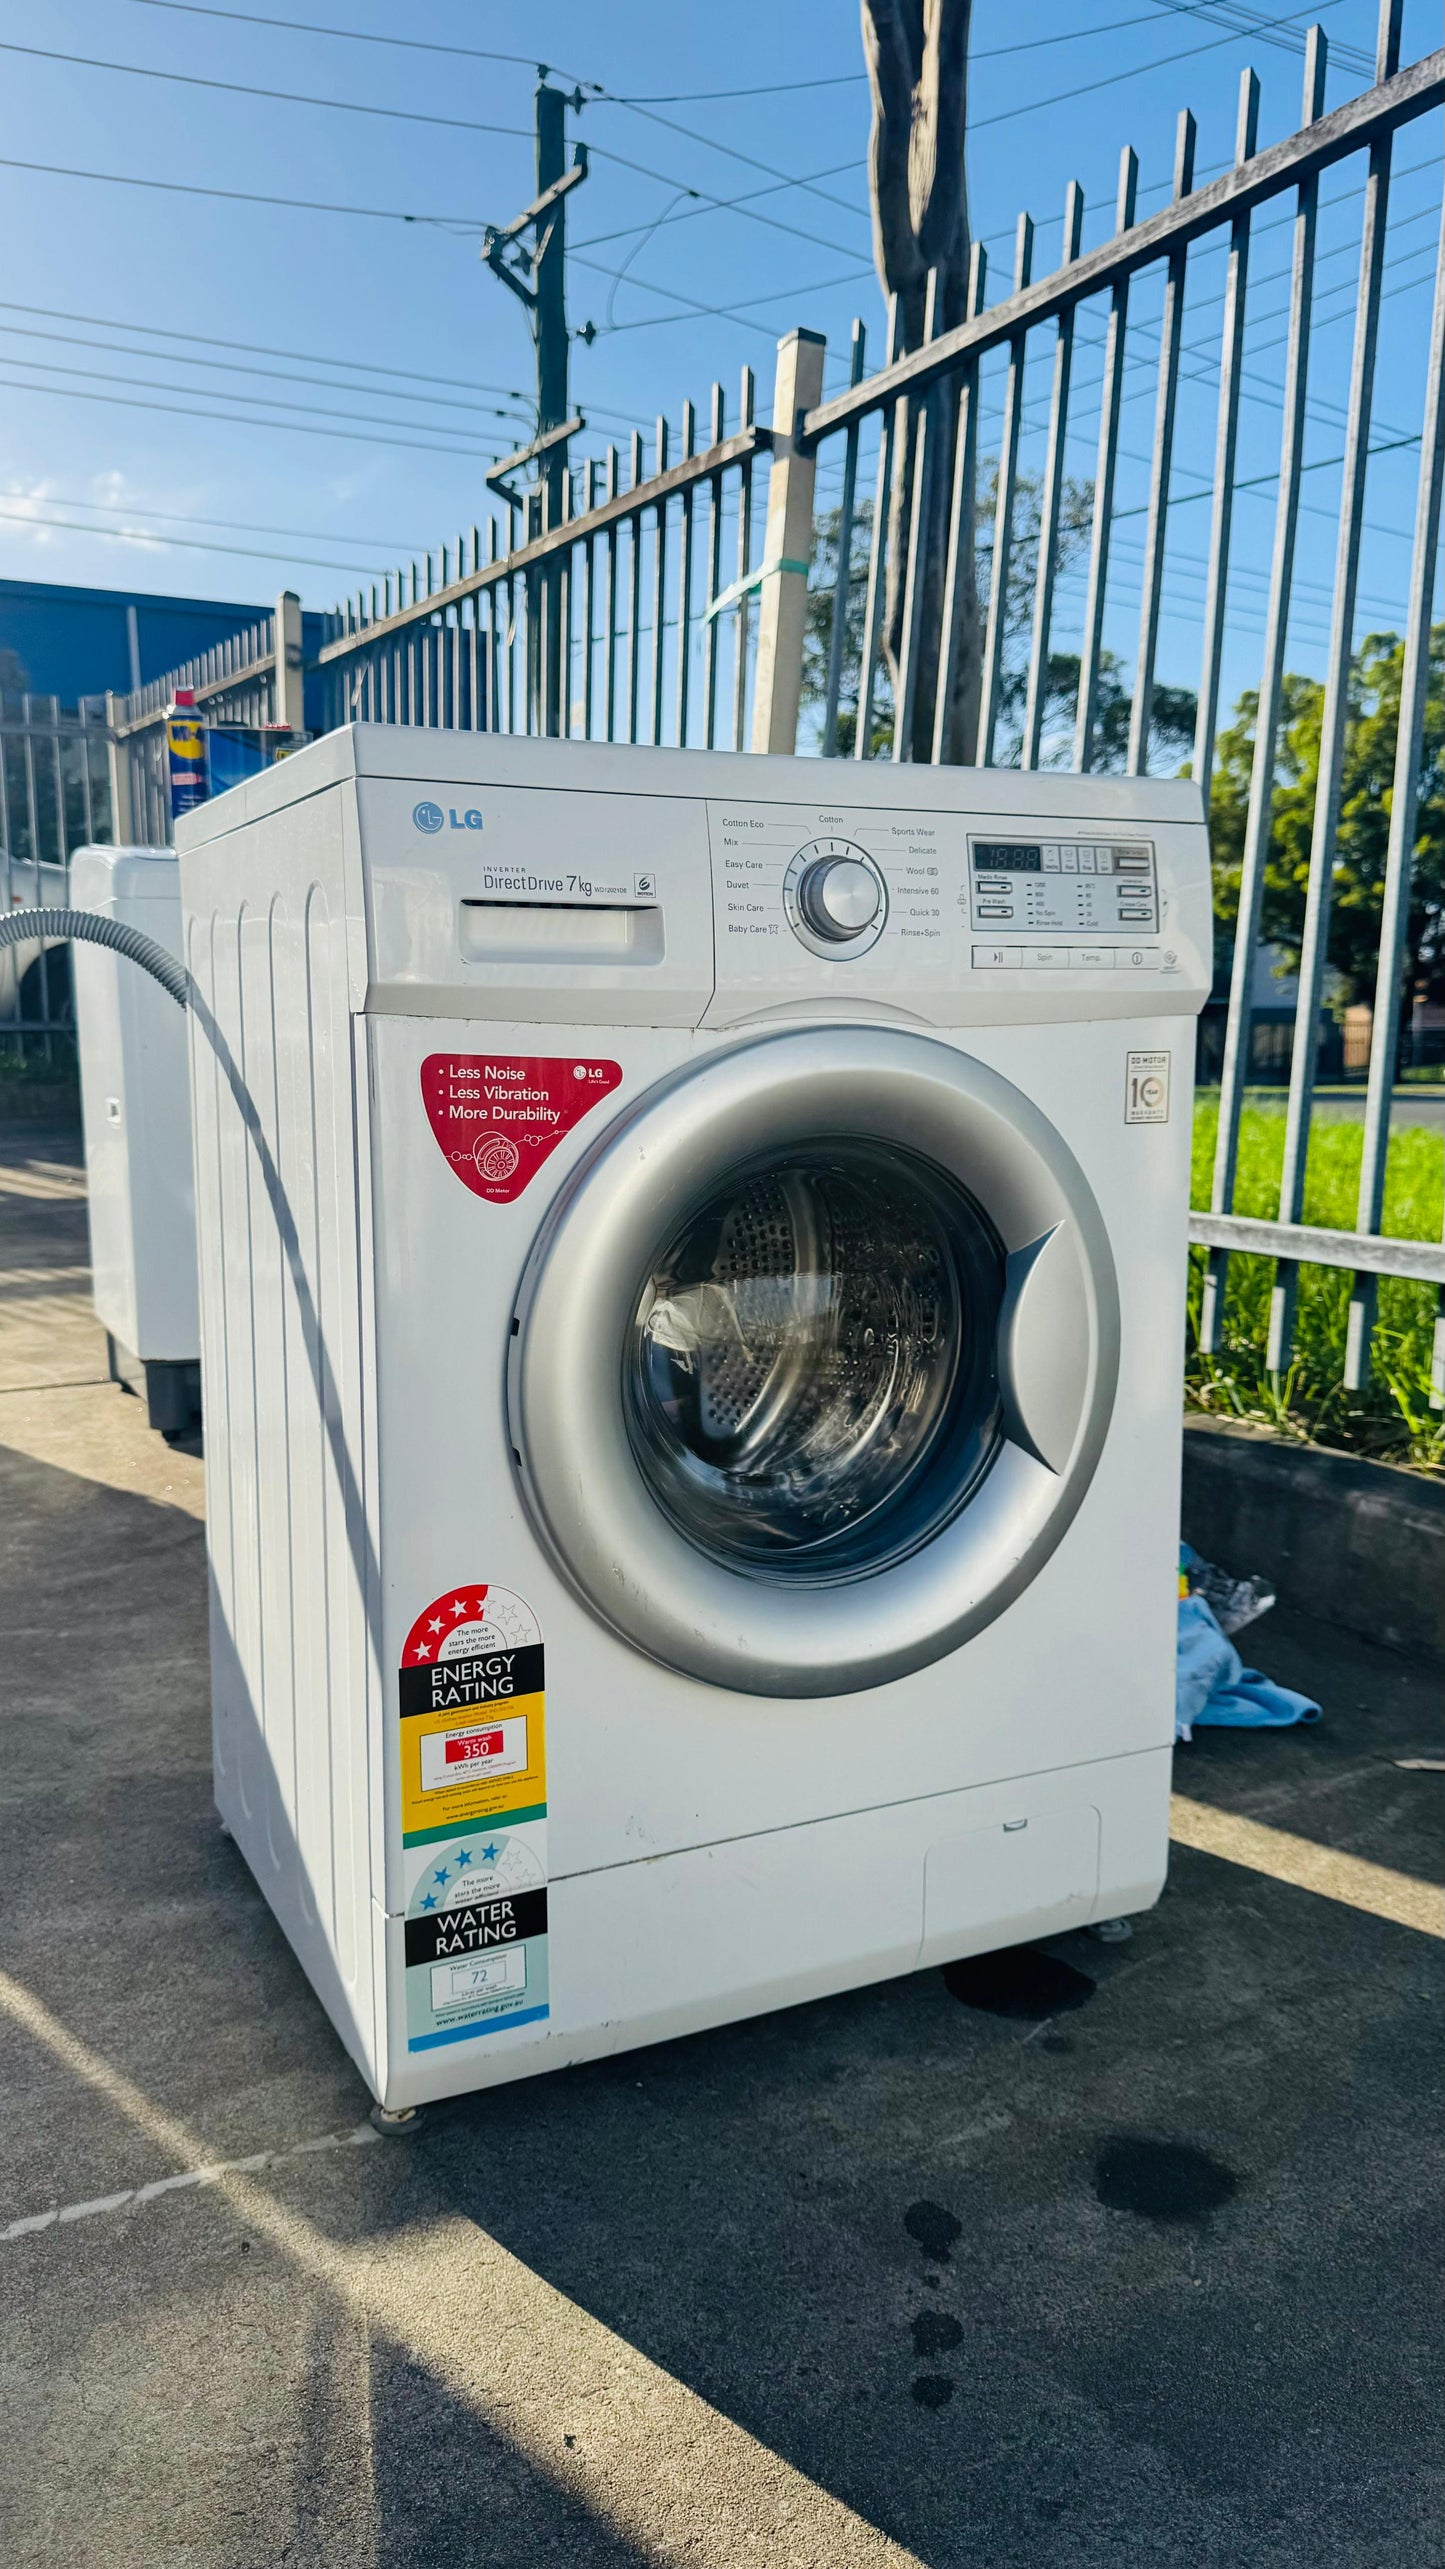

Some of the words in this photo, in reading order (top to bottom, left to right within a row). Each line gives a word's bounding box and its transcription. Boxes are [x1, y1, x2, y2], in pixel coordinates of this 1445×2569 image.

[449, 808, 483, 830] LG
[723, 819, 748, 827] Cotton
[750, 820, 764, 828] Eco
[819, 815, 843, 824] Cotton
[892, 827, 915, 836] Sports
[916, 828, 935, 836] Wear
[724, 838, 738, 846] Mix
[909, 846, 936, 854] Delicate
[725, 860, 743, 869] Easy
[746, 861, 763, 869] Care
[906, 867, 925, 875] Wool
[727, 881, 749, 889] Duvet
[728, 903, 744, 911] Skin
[747, 904, 764, 912] Care
[910, 908, 929, 916] Quick
[728, 924, 747, 934] Baby
[750, 925, 767, 933] Care
[901, 929, 940, 938] Rinse+Spin
[1142, 1056, 1166, 1064] MOTOR
[449, 1065, 480, 1079] Less
[484, 1066, 526, 1081] Noise
[589, 1069, 602, 1078] LG
[449, 1085, 480, 1099] Less
[483, 1085, 549, 1102] Vibration
[449, 1105, 488, 1119] More
[492, 1106, 560, 1124] Durability
[448, 1647, 469, 1655] energy
[471, 1642, 496, 1652] efficient
[431, 1654, 516, 1687] ENERGY
[432, 1676, 514, 1708] RATING
[446, 1730, 464, 1738] Energy
[466, 1723, 502, 1734] consumption
[458, 1738, 476, 1746] Warm
[464, 1742, 489, 1759] 350
[476, 1875, 493, 1883] more
[437, 1900, 515, 1934] WATER
[436, 1920, 516, 1956] RATING
[449, 1963, 468, 1971] Water
[469, 1954, 507, 1966] Consumption
[472, 1969, 488, 1984] 72
[436, 2000, 524, 2026] www.waterrating.gov.au
